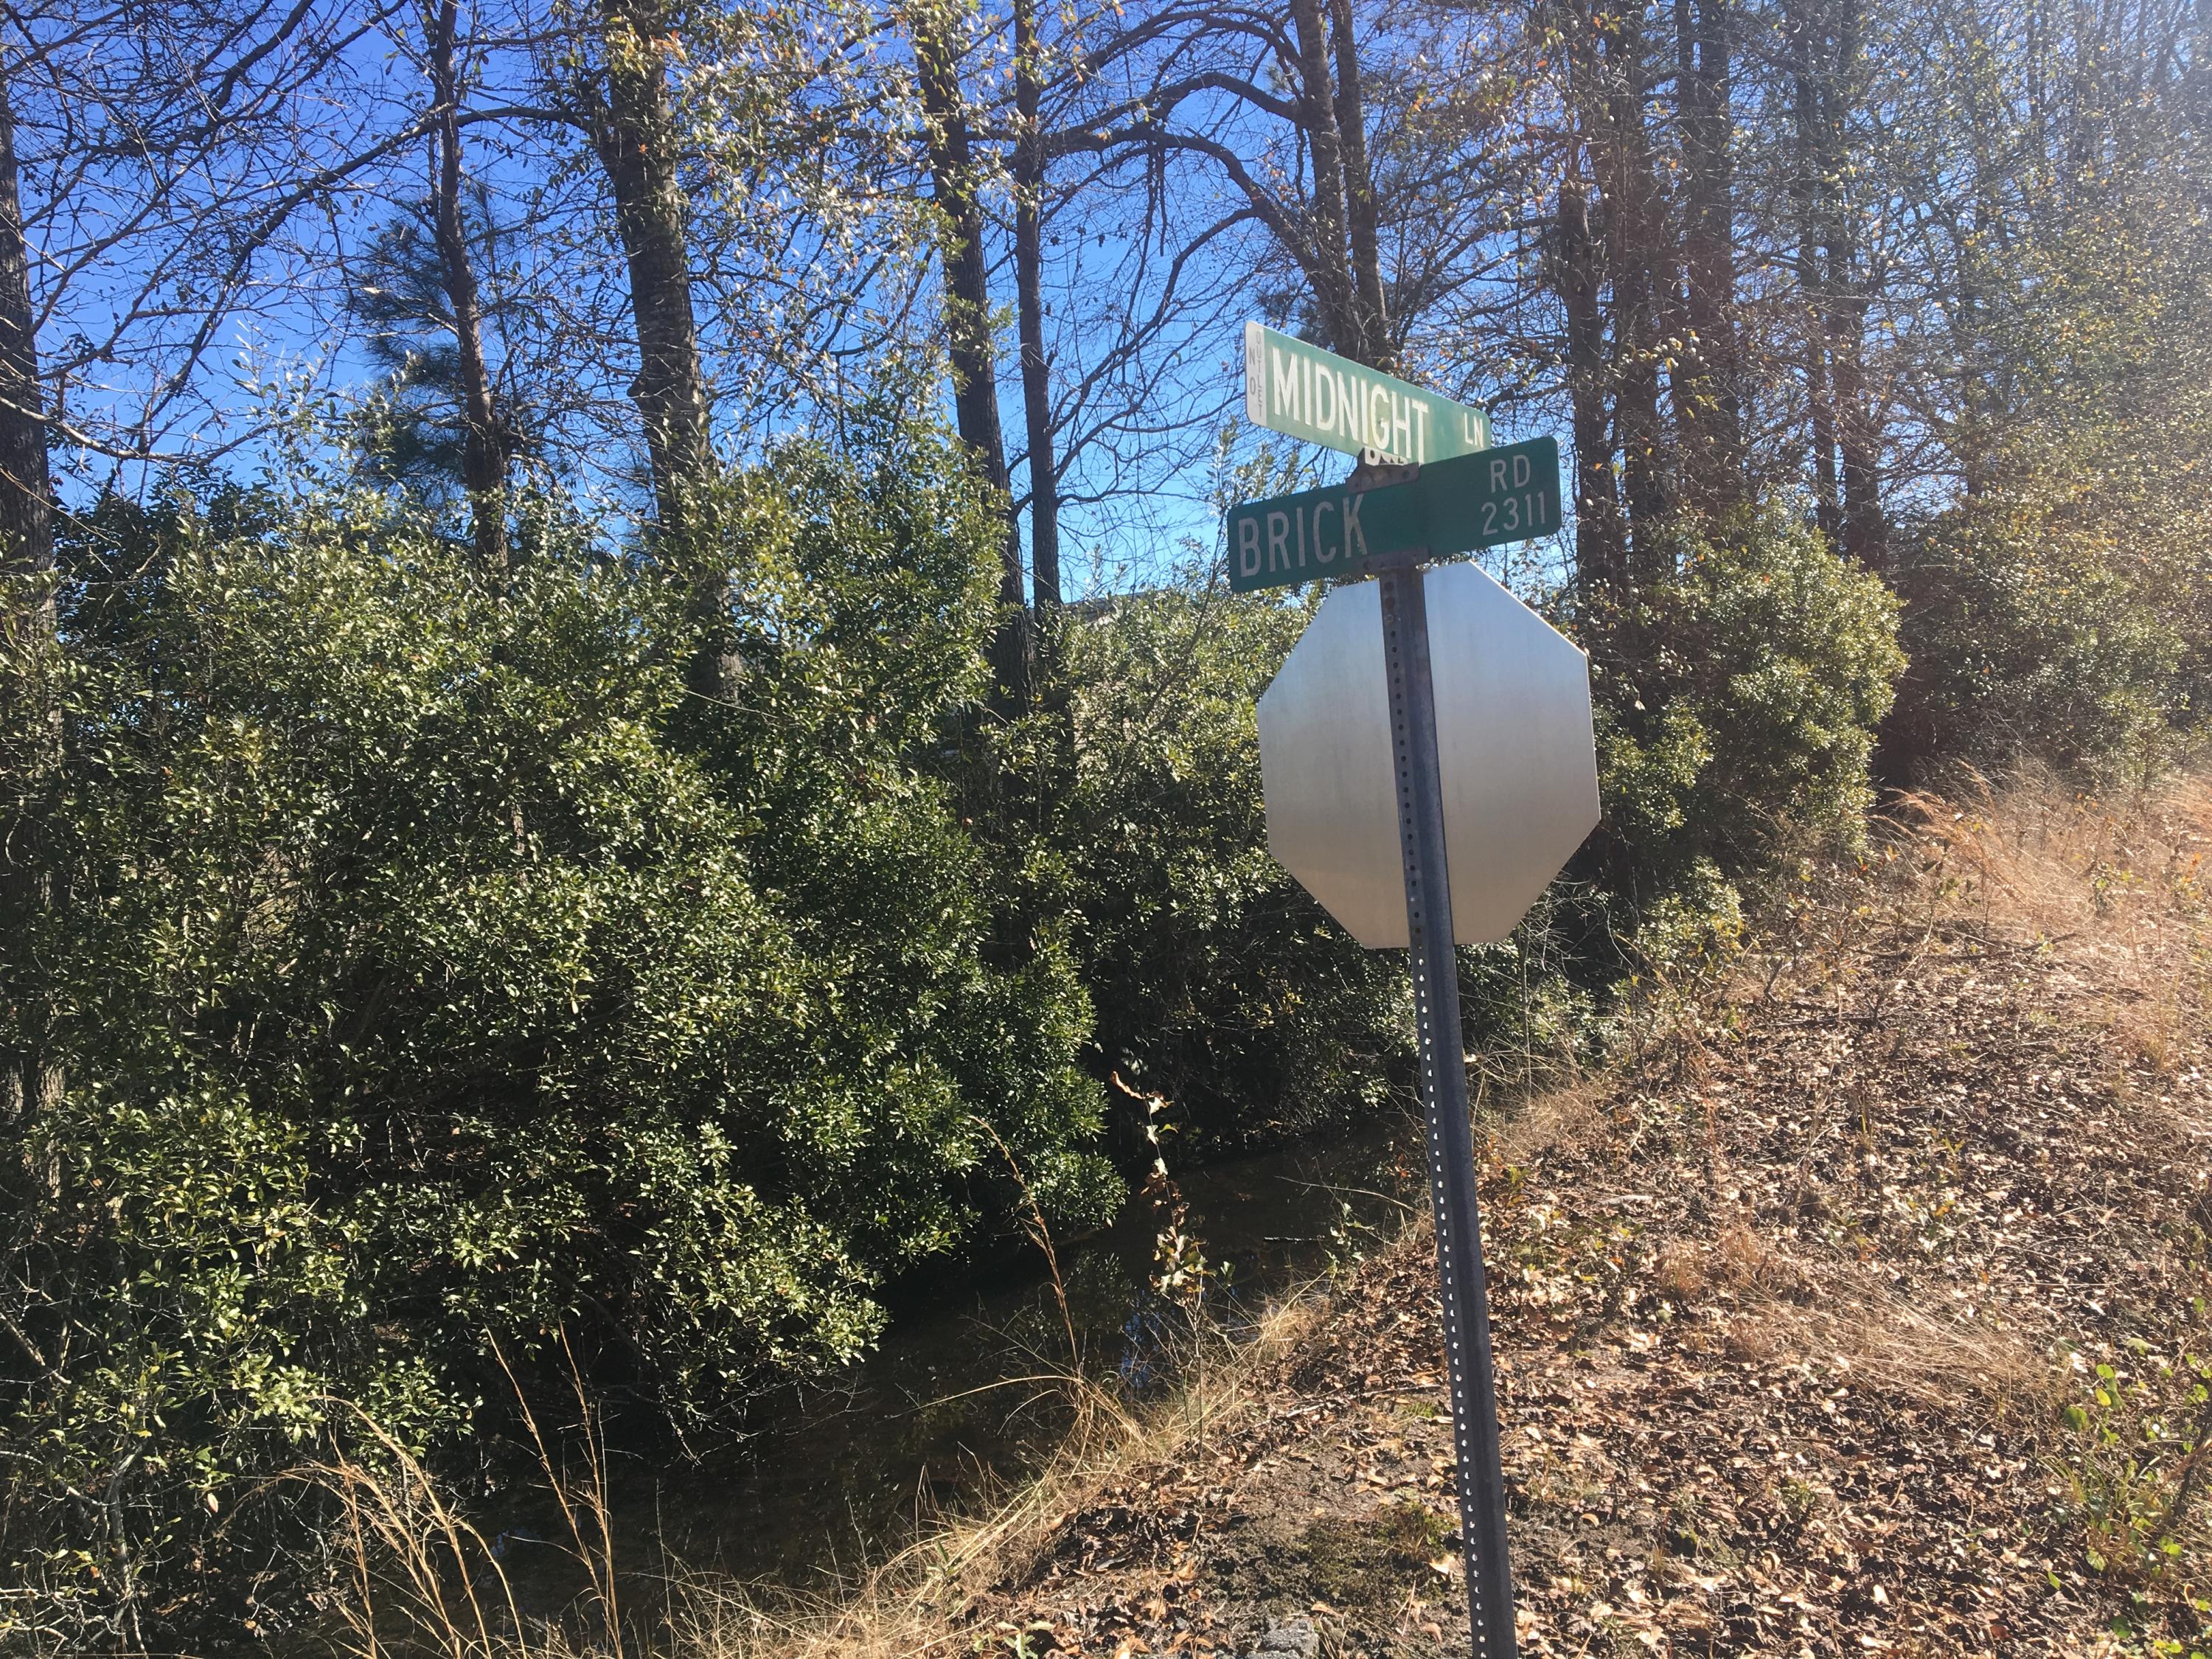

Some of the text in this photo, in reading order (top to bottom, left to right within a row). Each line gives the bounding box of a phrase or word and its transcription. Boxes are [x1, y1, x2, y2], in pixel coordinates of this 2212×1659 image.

[1248, 347, 1256, 396] NO
[1272, 347, 1484, 466] MIDNIGHT LN
[1238, 454, 1531, 577] BRICK RD
[1481, 491, 1546, 536] 2311
